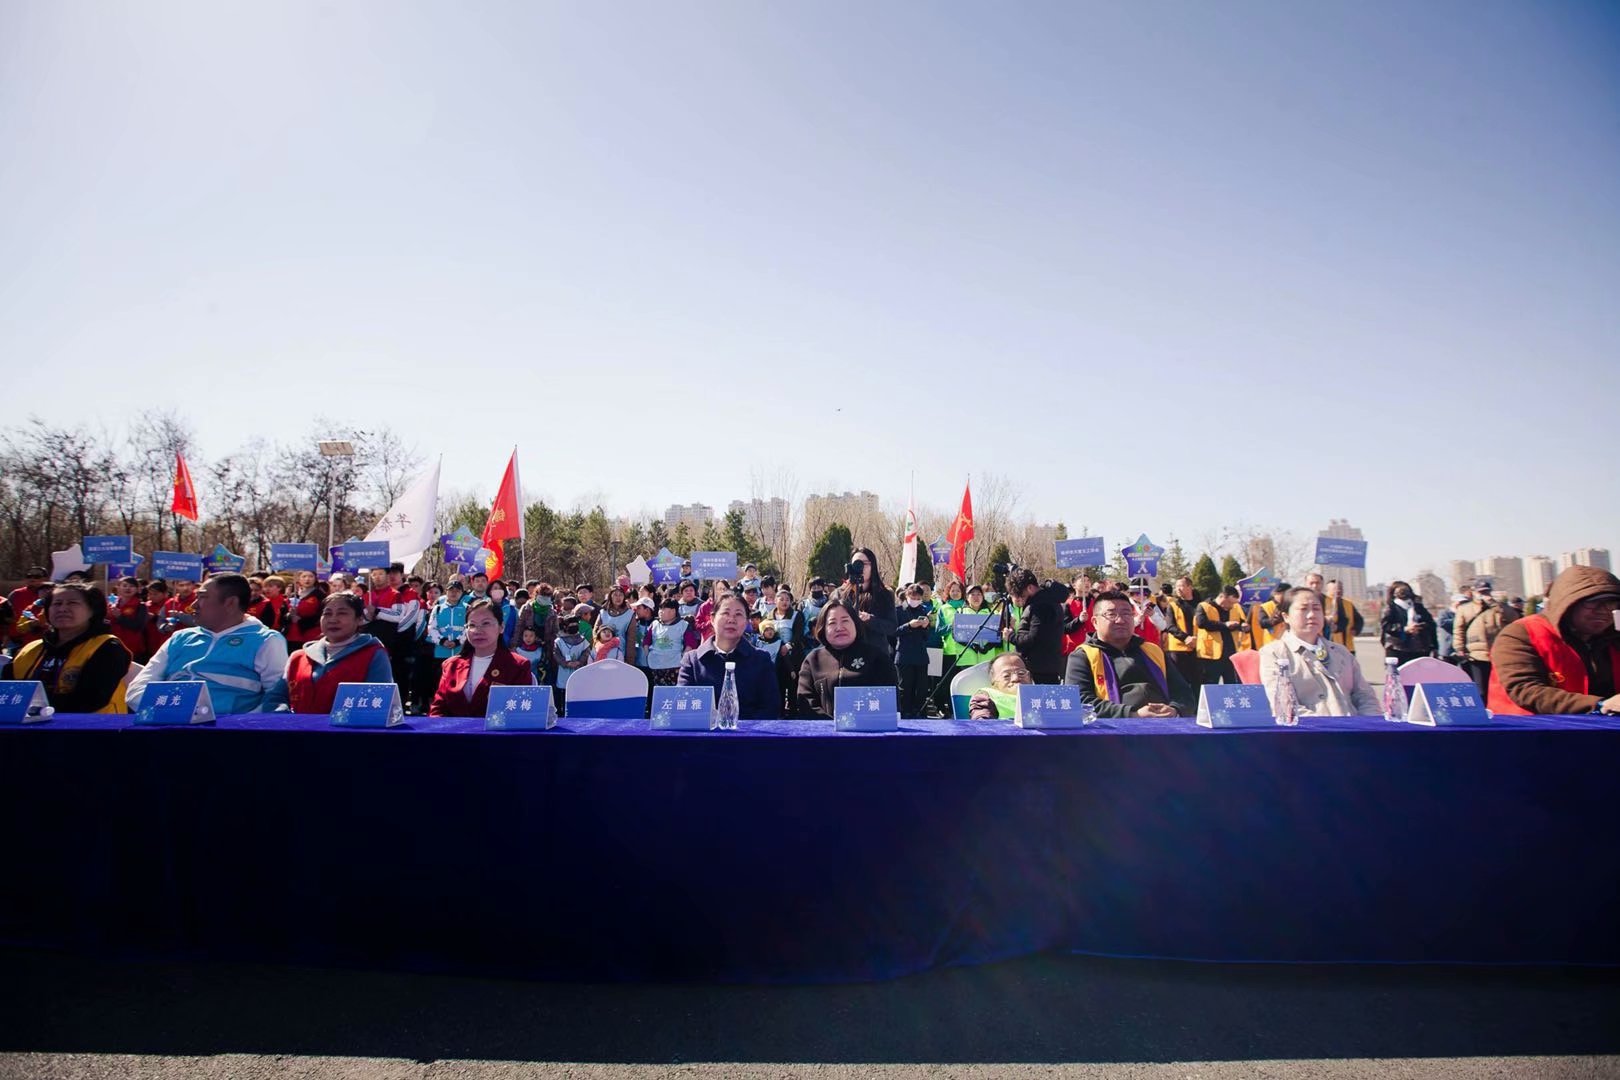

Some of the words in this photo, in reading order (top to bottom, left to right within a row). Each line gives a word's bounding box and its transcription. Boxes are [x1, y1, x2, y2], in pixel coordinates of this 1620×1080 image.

[343, 697, 383, 708] 赵红敏
[661, 699, 703, 711] 左丽雅
[1223, 697, 1251, 708] 张亮
